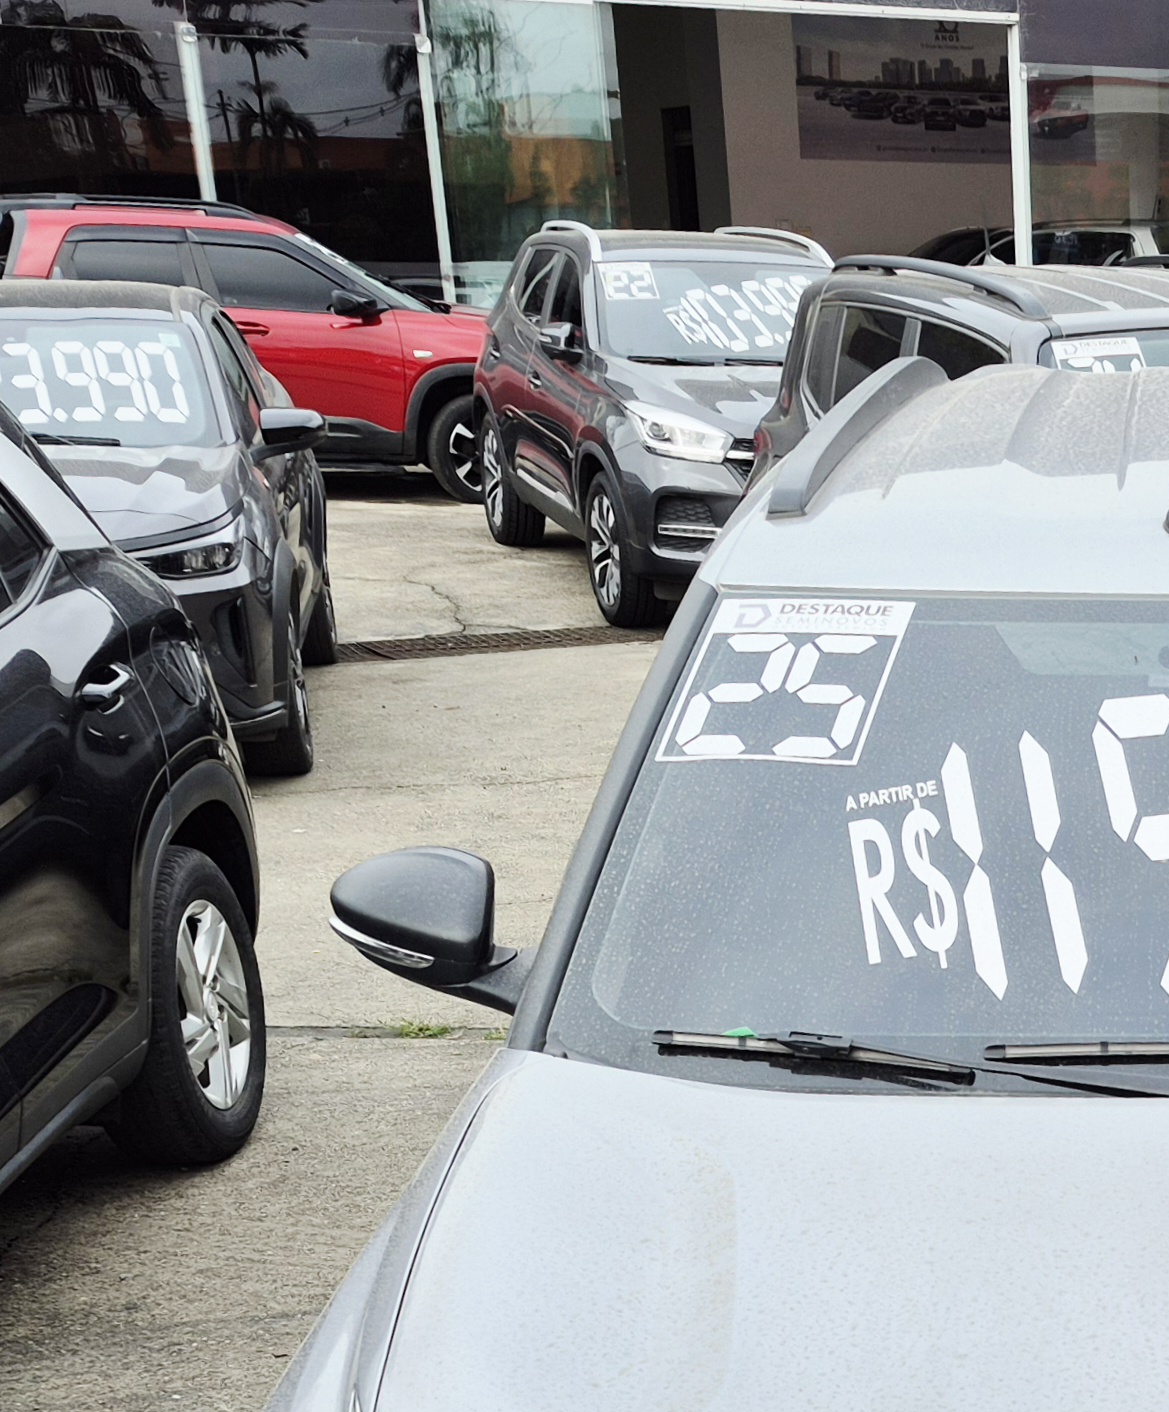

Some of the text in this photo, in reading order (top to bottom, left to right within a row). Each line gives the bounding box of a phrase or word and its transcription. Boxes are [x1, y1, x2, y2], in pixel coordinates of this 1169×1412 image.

[774, 616, 888, 627] SEMINOVOS
[780, 603, 894, 617] DESTAQUE
[675, 633, 878, 757] 25
[846, 780, 939, 812] A PARTIR DE
